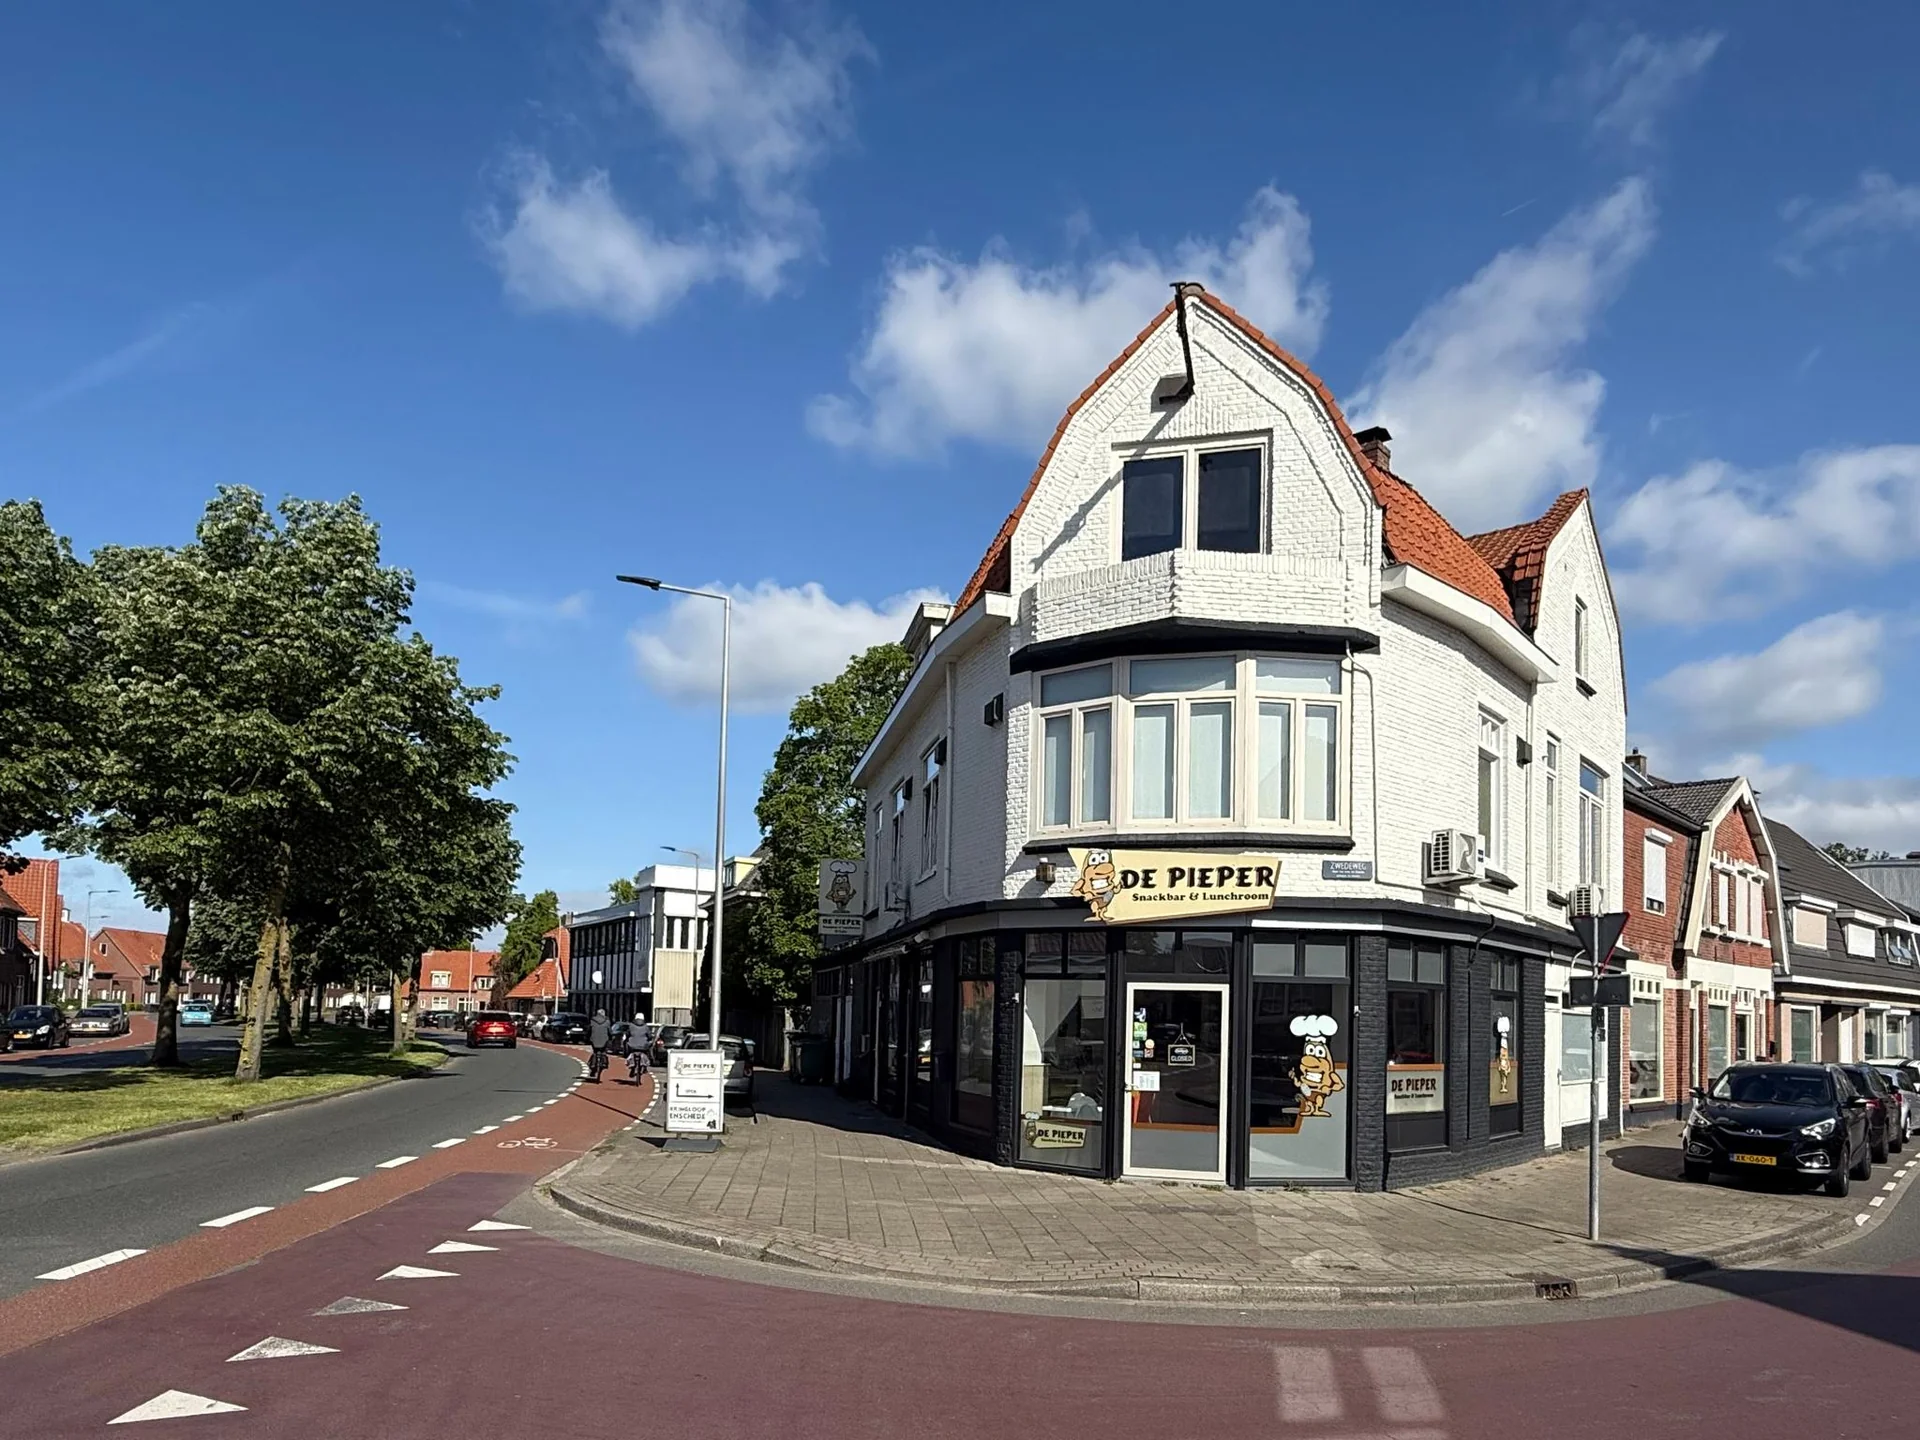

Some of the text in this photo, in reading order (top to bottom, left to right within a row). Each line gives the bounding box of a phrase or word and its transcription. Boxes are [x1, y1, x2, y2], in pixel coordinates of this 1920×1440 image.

[1330, 861, 1367, 870] ZWEDEWEG
[1119, 866, 1275, 889] DE PIEPER
[1132, 892, 1269, 902] Snackbar & Lunchroom
[834, 918, 861, 926] PIEPER
[1391, 1077, 1437, 1091] DE PIEPER
[1037, 1129, 1084, 1140] DE PIEPER
